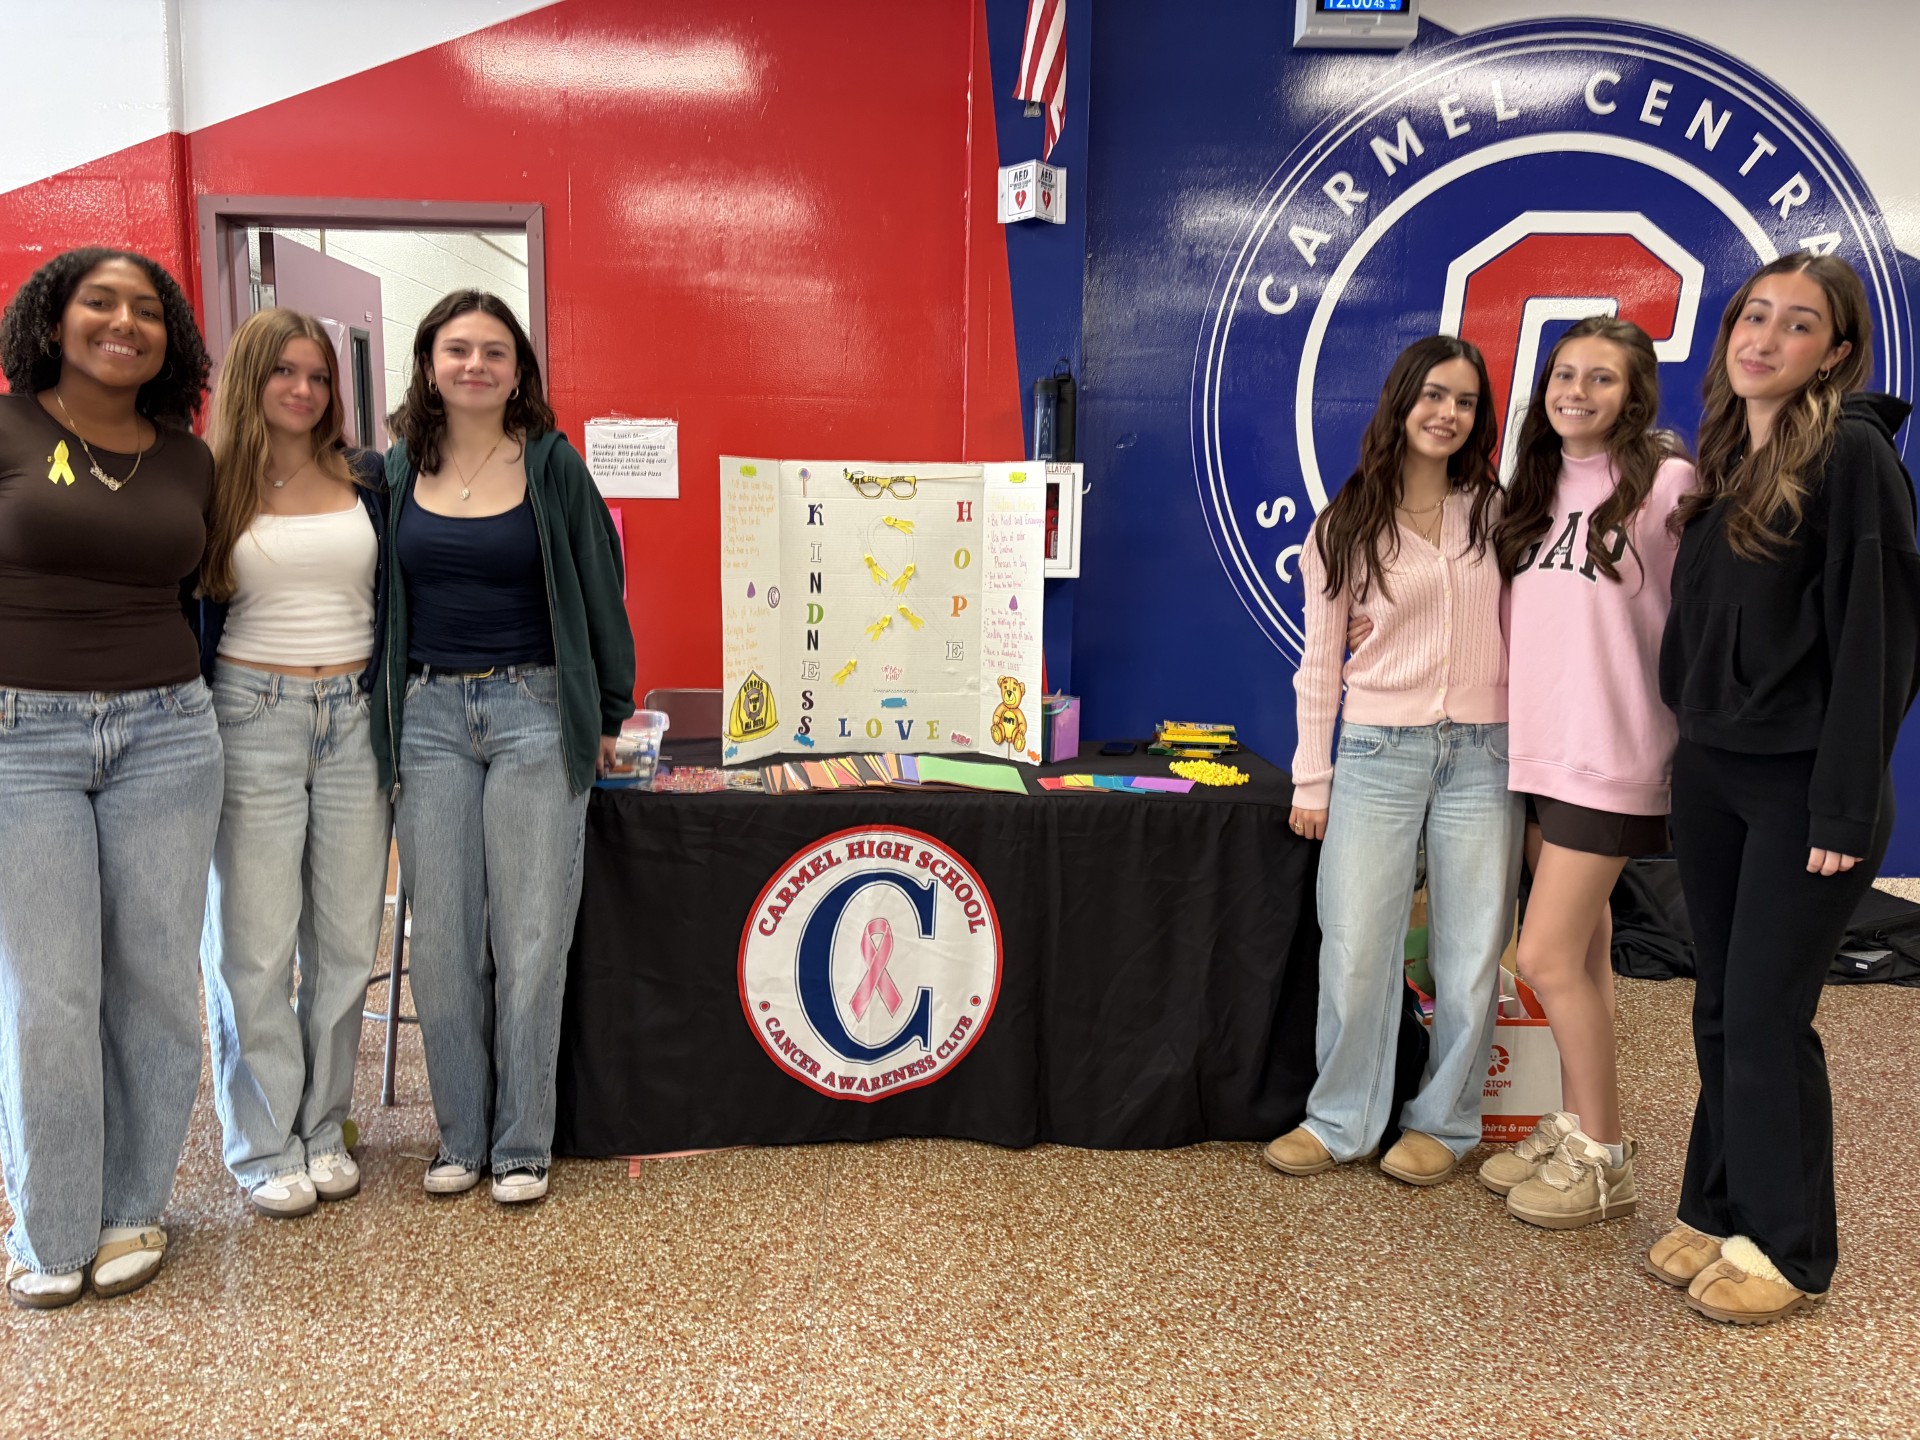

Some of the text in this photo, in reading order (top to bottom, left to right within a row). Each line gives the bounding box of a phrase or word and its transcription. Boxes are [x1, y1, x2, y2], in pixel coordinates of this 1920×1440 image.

[1014, 169, 1028, 182] AED
[1257, 70, 1842, 315] CARMEL CENTRA
[798, 504, 824, 735] KINDNESS
[946, 501, 973, 661] HOPE
[838, 718, 940, 740] LOVE
[758, 840, 986, 936] CARMEL HIGH SCHOOL
[795, 868, 938, 1065] C
[765, 1015, 974, 1092] CANCER AWARENESS CLUB
[1484, 1080, 1512, 1088] STOM
[1482, 1124, 1506, 1132] shirts
[1508, 1124, 1516, 1132] &
